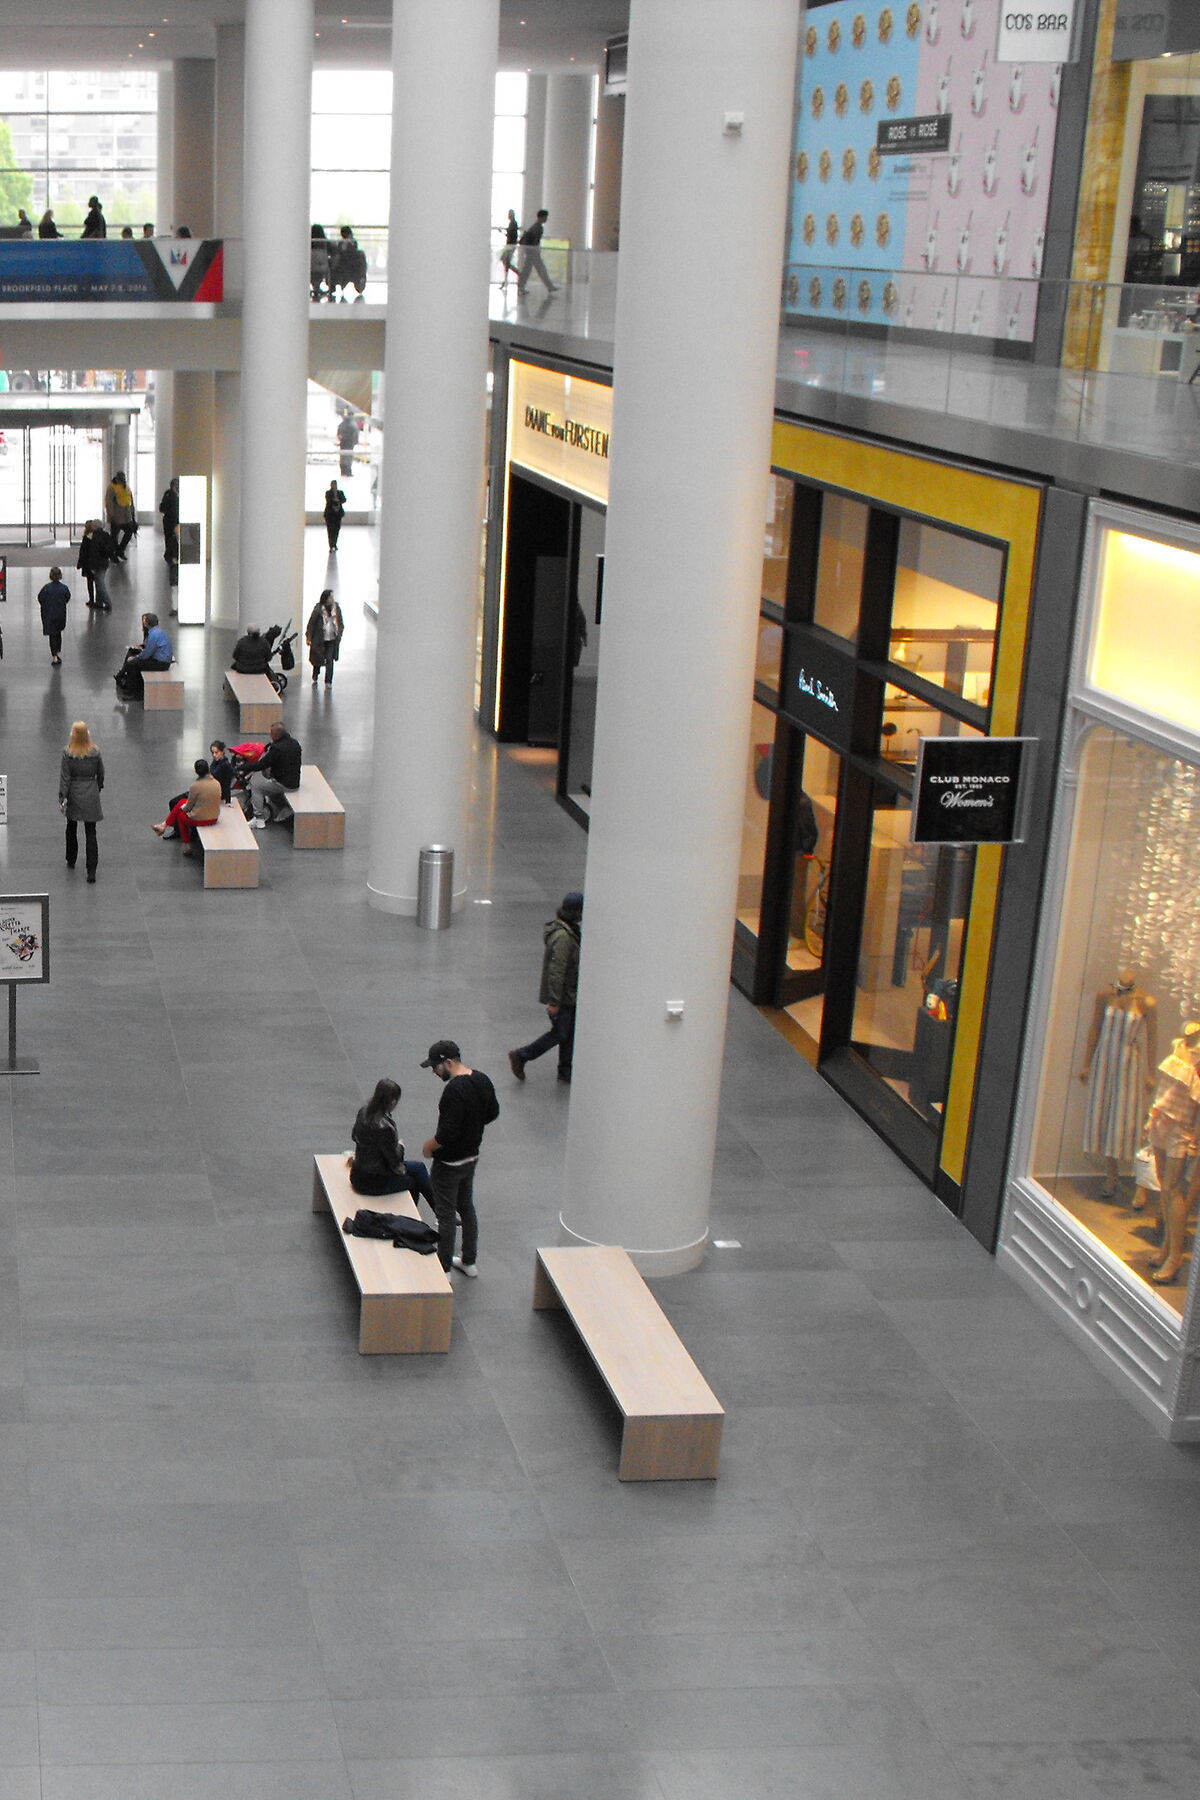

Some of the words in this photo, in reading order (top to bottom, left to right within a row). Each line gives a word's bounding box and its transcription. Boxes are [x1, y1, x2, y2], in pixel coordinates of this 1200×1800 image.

[1005, 13, 1033, 31] COS
[1037, 13, 1068, 31] BAR
[2, 285, 52, 293] BROOKFIELD
[54, 285, 77, 293] PLACE
[940, 789, 994, 808] Women's
